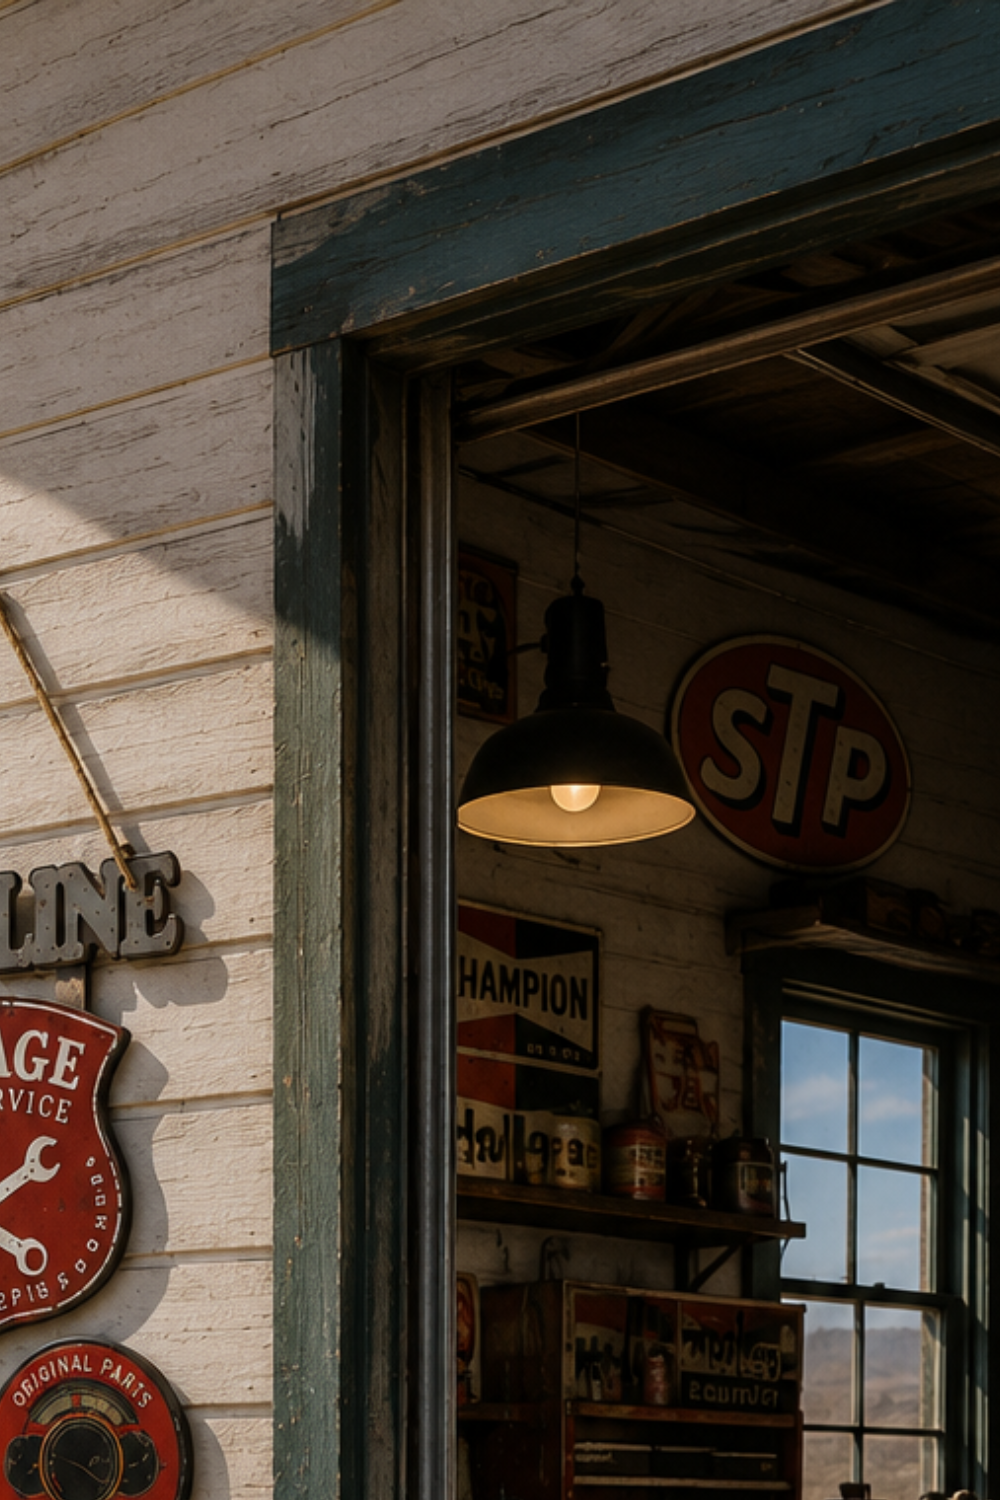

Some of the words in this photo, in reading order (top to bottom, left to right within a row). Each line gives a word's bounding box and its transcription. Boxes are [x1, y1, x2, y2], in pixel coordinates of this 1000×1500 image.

[700, 663, 887, 827] STP
[12, 1354, 93, 1408] ORIGINAL
[100, 1358, 153, 1409] PARTS
